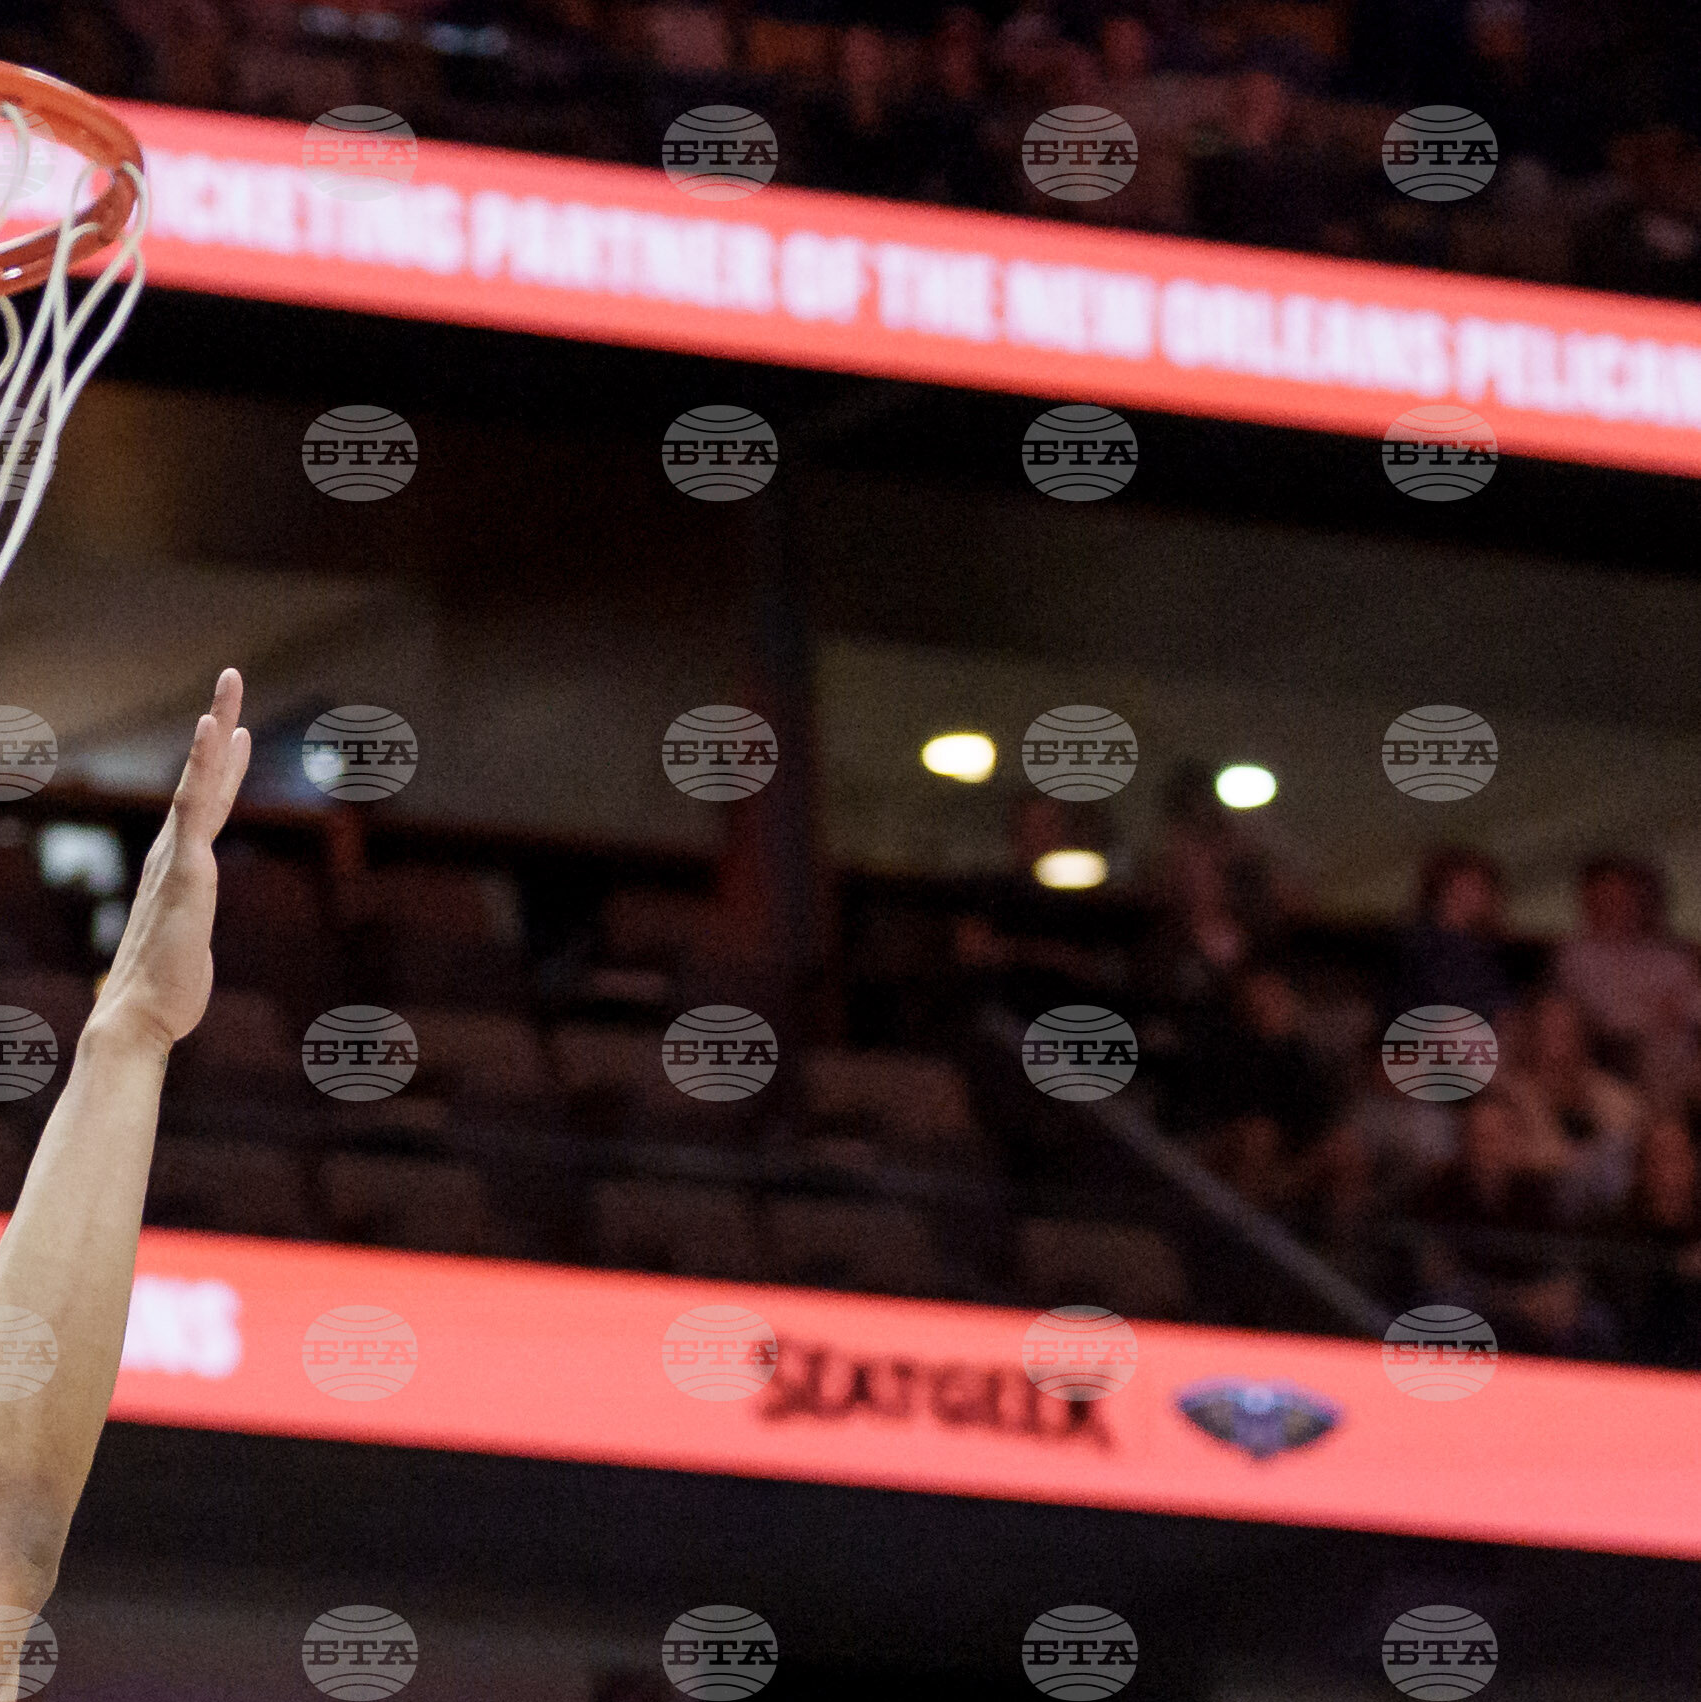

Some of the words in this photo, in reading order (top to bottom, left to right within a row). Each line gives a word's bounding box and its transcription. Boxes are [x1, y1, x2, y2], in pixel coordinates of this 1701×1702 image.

[146, 147, 464, 277] ICKETING
[468, 189, 775, 315] PARTNER
[780, 229, 868, 326] OF
[873, 240, 997, 343] THE
[1002, 258, 1155, 361] NEW
[1159, 278, 1450, 398] ORLEANS
